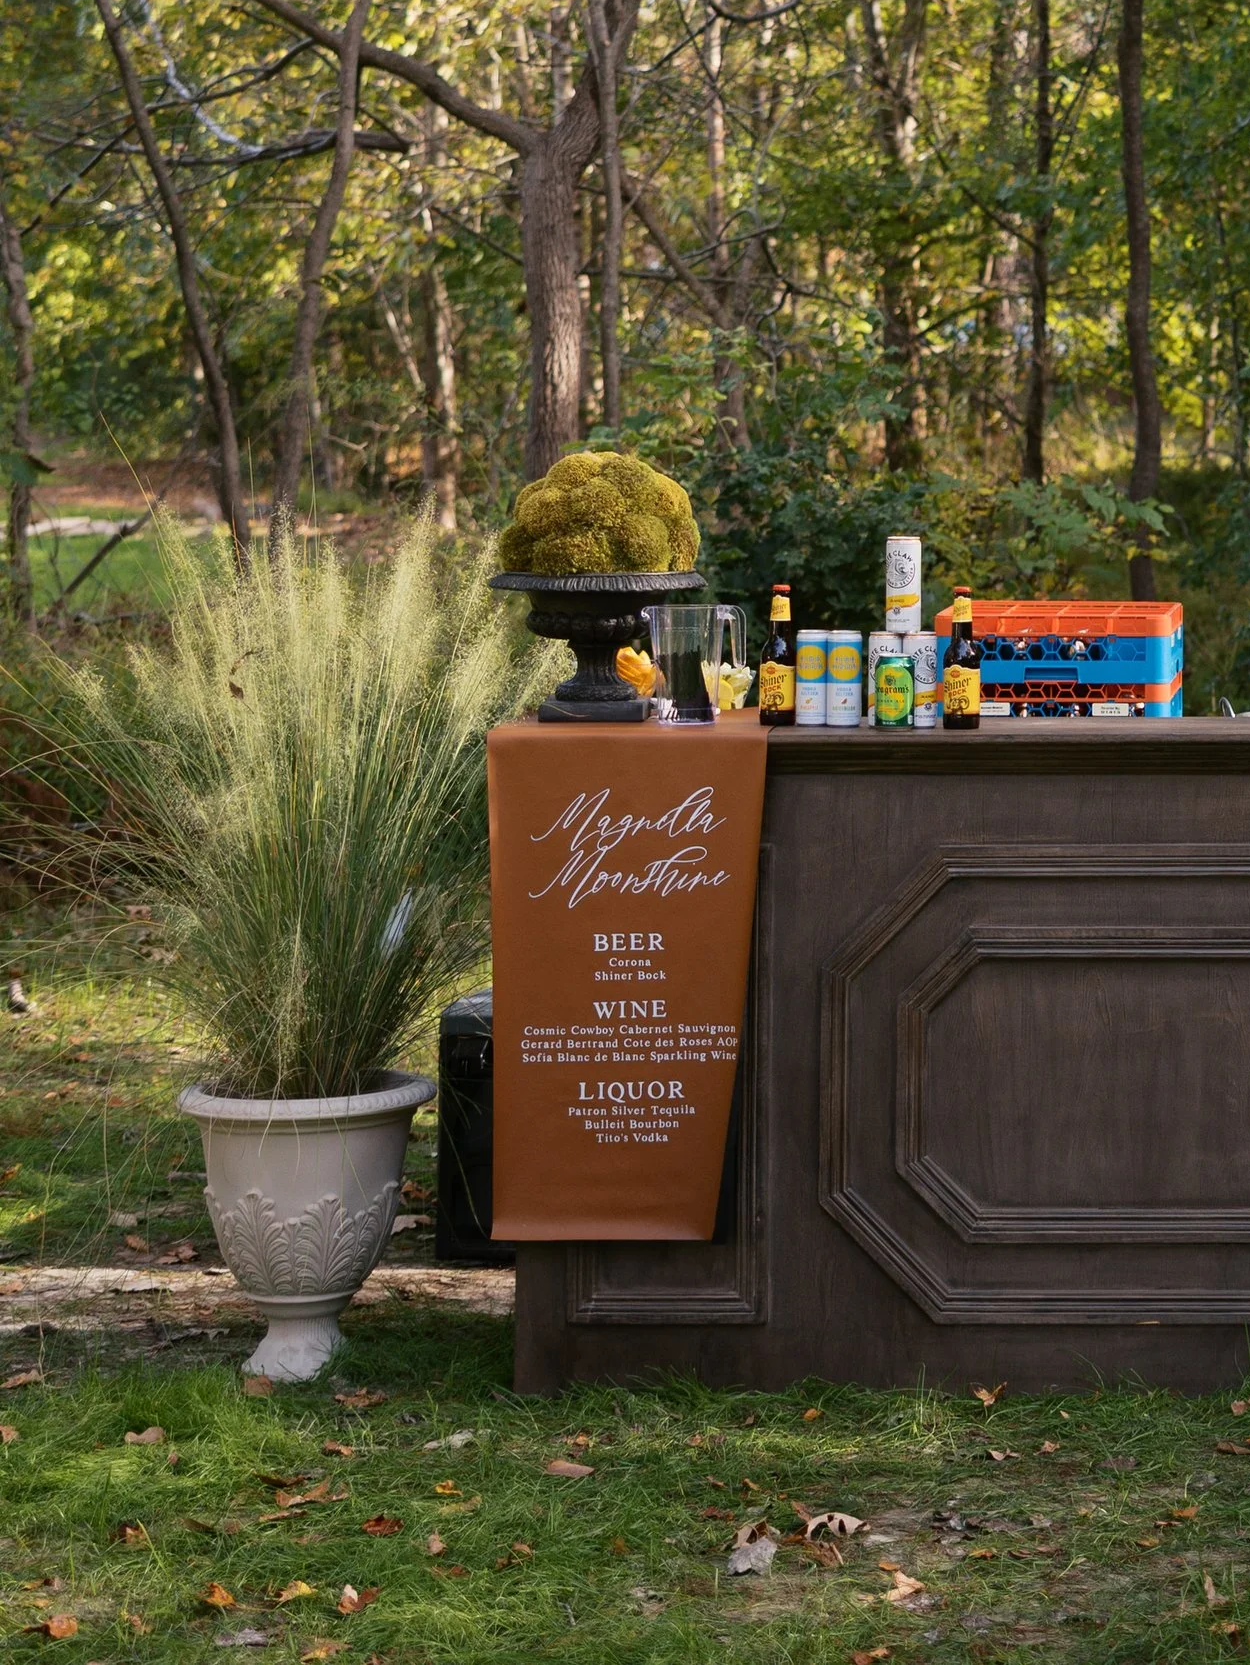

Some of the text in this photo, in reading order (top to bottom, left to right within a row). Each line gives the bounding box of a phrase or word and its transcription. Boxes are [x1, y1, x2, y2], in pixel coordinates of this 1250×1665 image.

[529, 846, 731, 909] Moonshine
[593, 933, 664, 952] BEER
[609, 957, 651, 967] Corona
[595, 971, 666, 981] Shiner Bock
[593, 1000, 667, 1019] WINE
[524, 1023, 736, 1037] Cosmic Cowboy Cabernet Sauvignon
[521, 1037, 738, 1049] Gerard Bertrand Cote des Roses AOP
[522, 1050, 737, 1063] Sofia Blanc de Blanc Sparkling Wine
[578, 1081, 685, 1103] LIQUOR
[568, 1105, 696, 1117] Patron Silver Tequila
[585, 1119, 679, 1130] Bulleit Bourbon
[596, 1133, 669, 1143] Tito's Vodka
